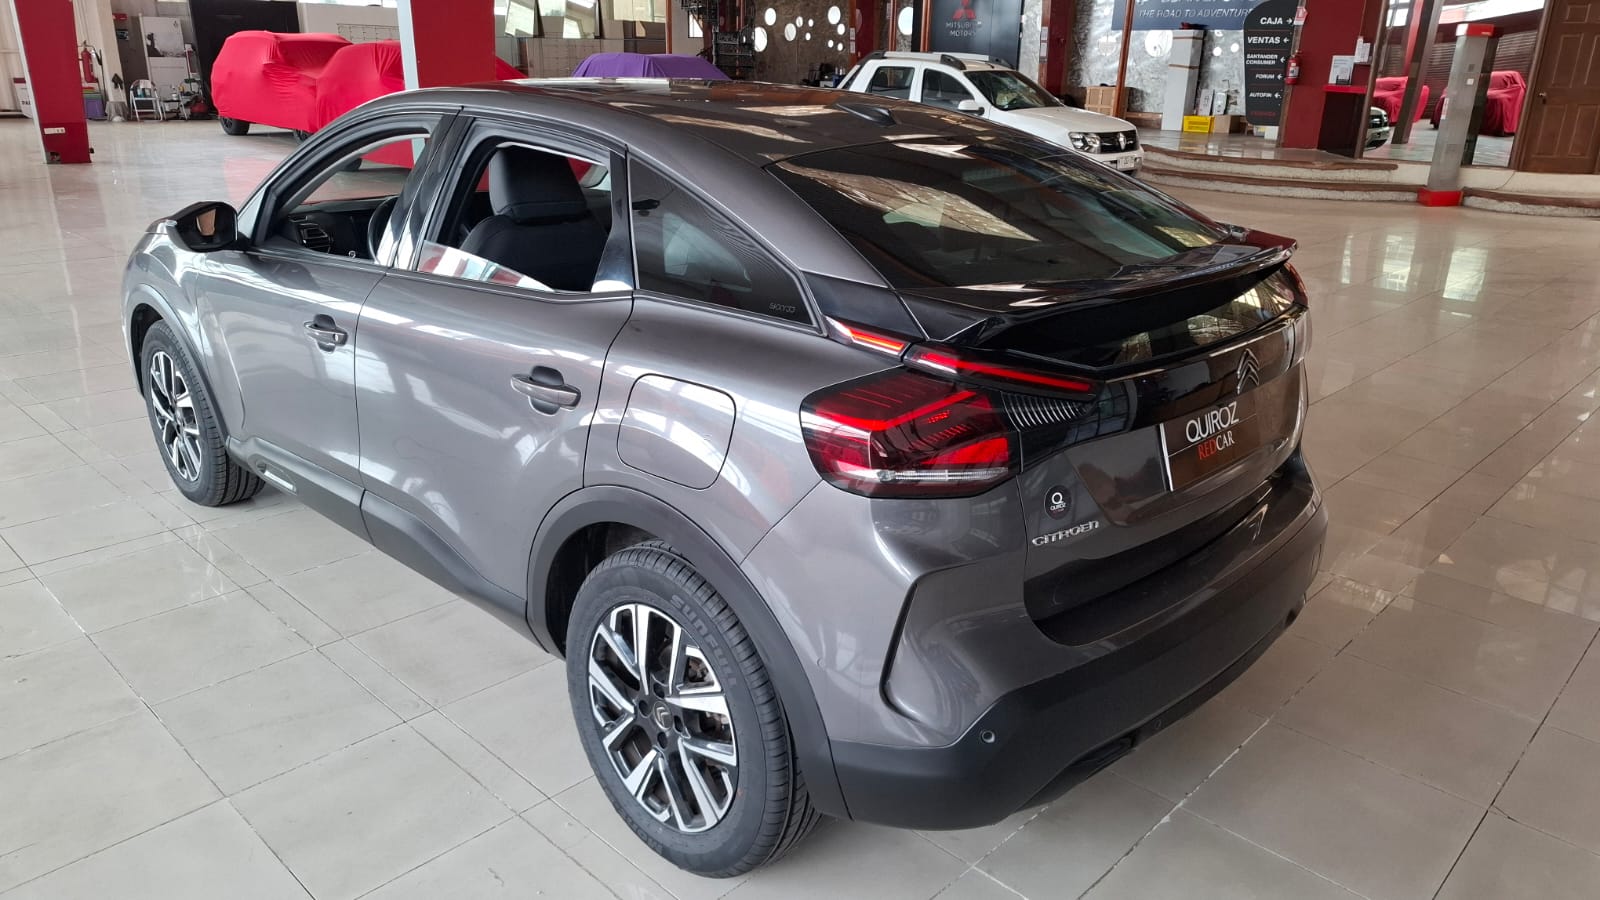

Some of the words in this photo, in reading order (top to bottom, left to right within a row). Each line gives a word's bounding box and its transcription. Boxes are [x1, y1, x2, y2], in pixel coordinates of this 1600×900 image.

[1139, 9, 1155, 17] THE
[1156, 9, 1182, 18] ROAD
[1184, 9, 1196, 17] TO
[945, 21, 981, 29] MITSUBI
[1259, 17, 1283, 25] CAJA
[1247, 36, 1281, 44] VENTAS
[1185, 400, 1240, 443] QUIROZ
